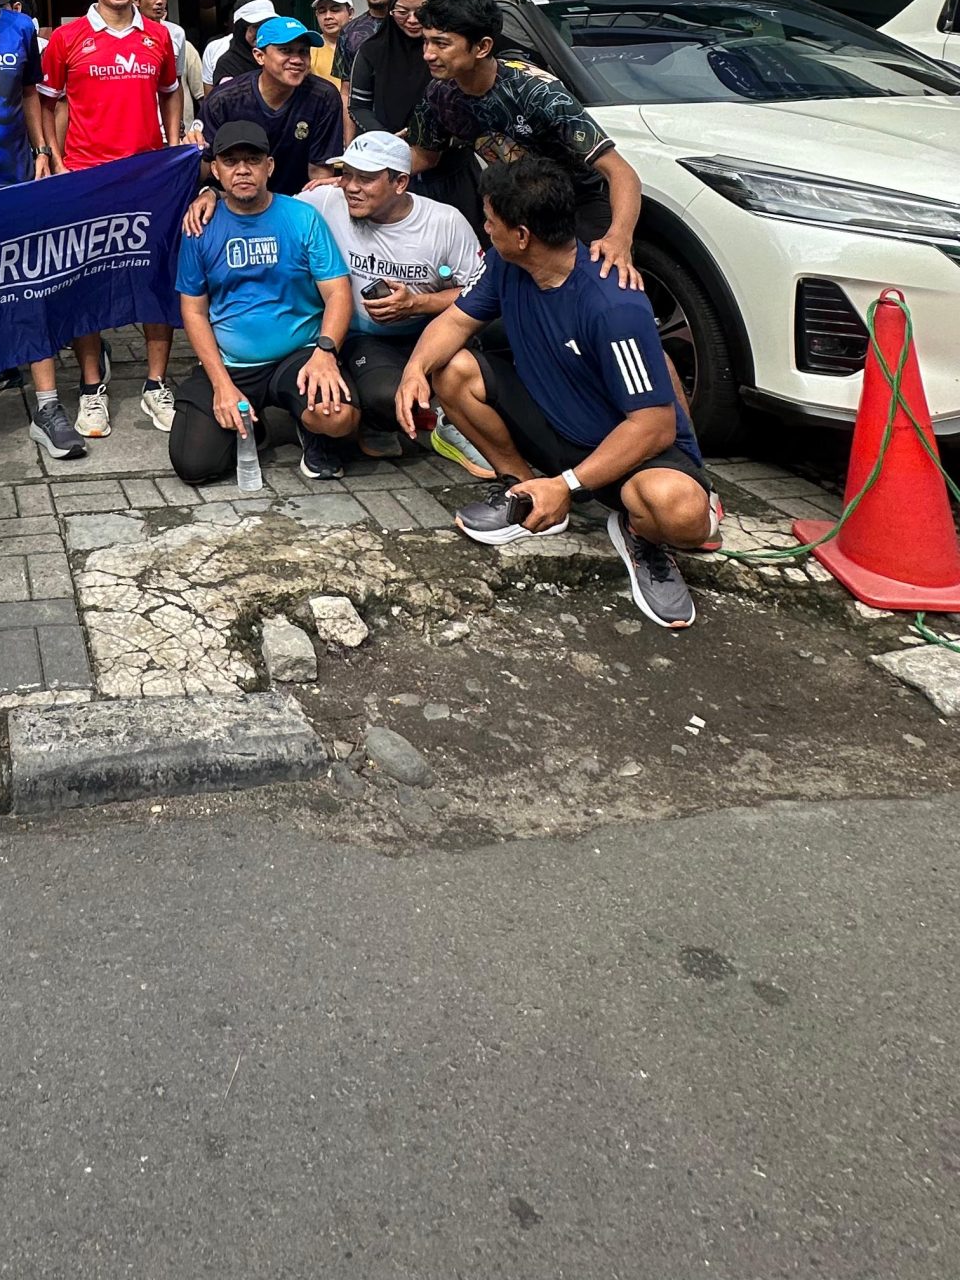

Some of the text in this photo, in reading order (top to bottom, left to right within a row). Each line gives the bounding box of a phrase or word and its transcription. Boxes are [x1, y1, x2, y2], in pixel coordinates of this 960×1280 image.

[248, 241, 277, 255] LAWU
[250, 255, 278, 265] ULTRA
[349, 252, 369, 272] TDA
[377, 261, 429, 278] RUNNERS
[23, 272, 81, 300] Ownernya
[83, 257, 151, 277] Lari-Larian
